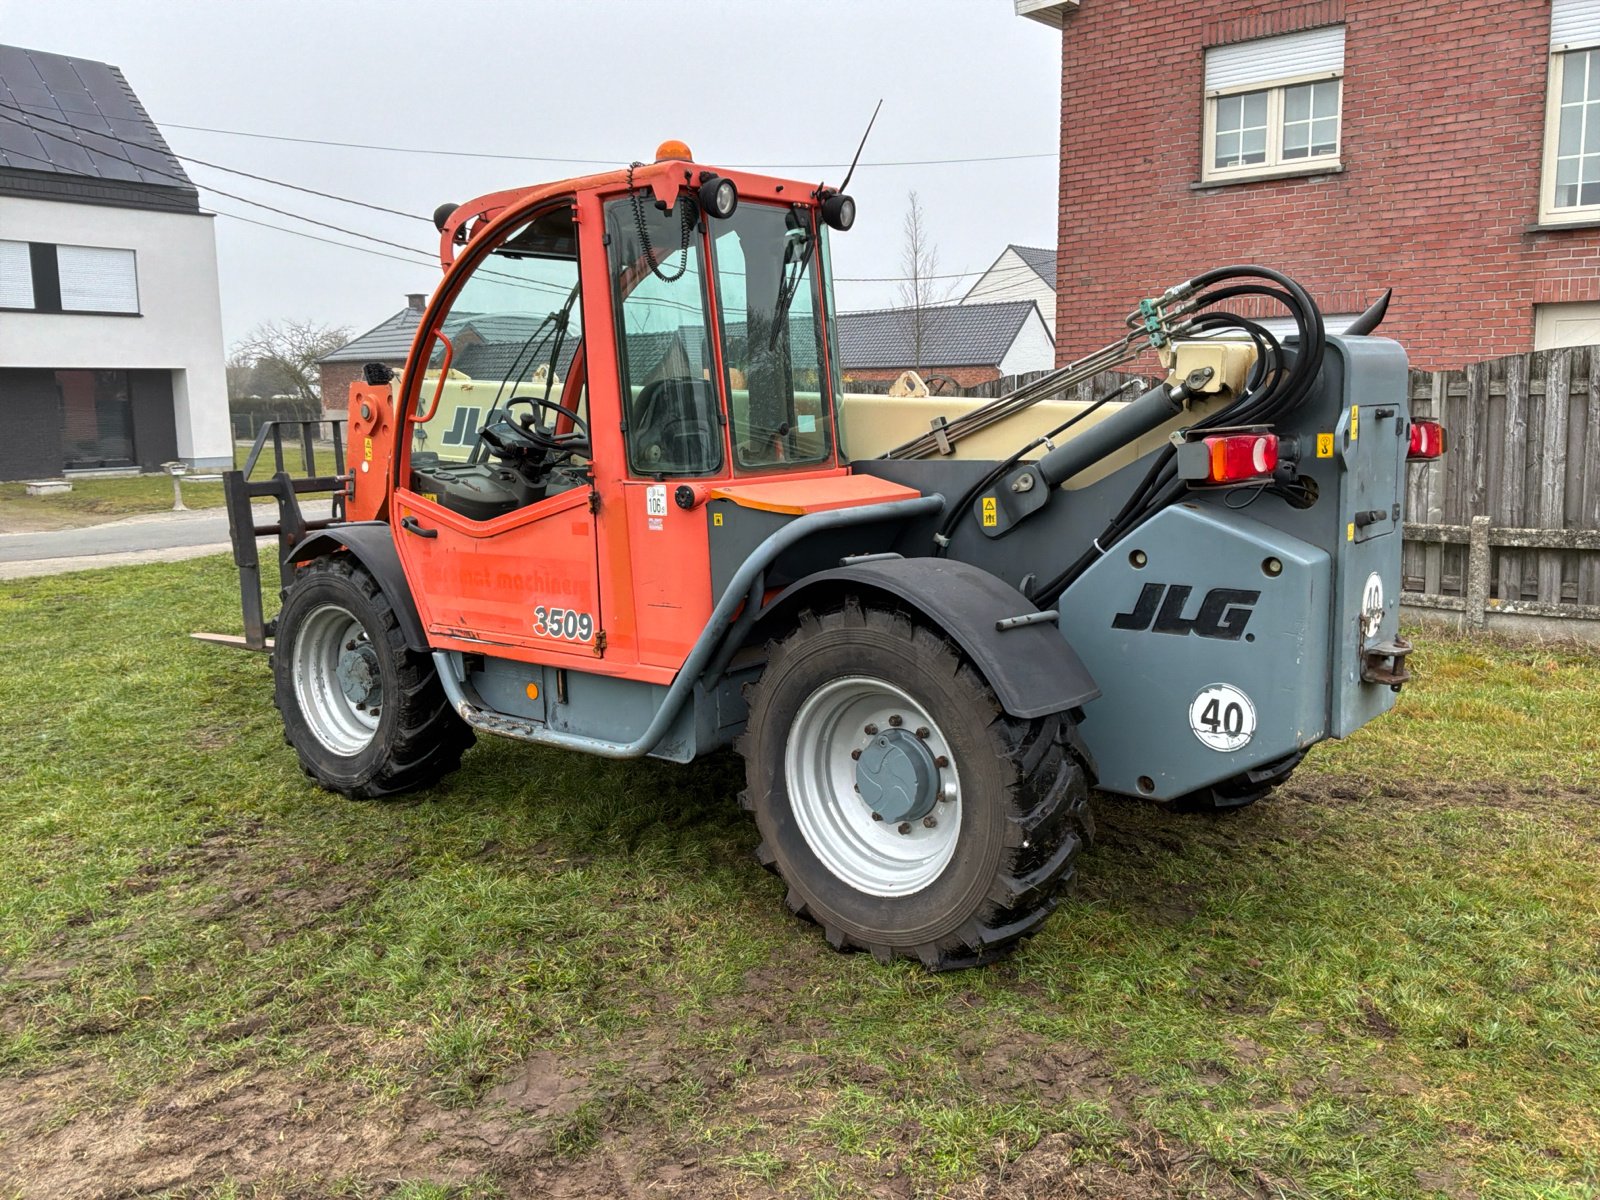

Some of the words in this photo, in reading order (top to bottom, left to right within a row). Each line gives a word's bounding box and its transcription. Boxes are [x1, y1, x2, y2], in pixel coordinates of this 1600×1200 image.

[649, 497, 661, 513] 106
[533, 606, 594, 642] 3509
[1111, 582, 1262, 641] JLG
[1200, 698, 1244, 738] 40
